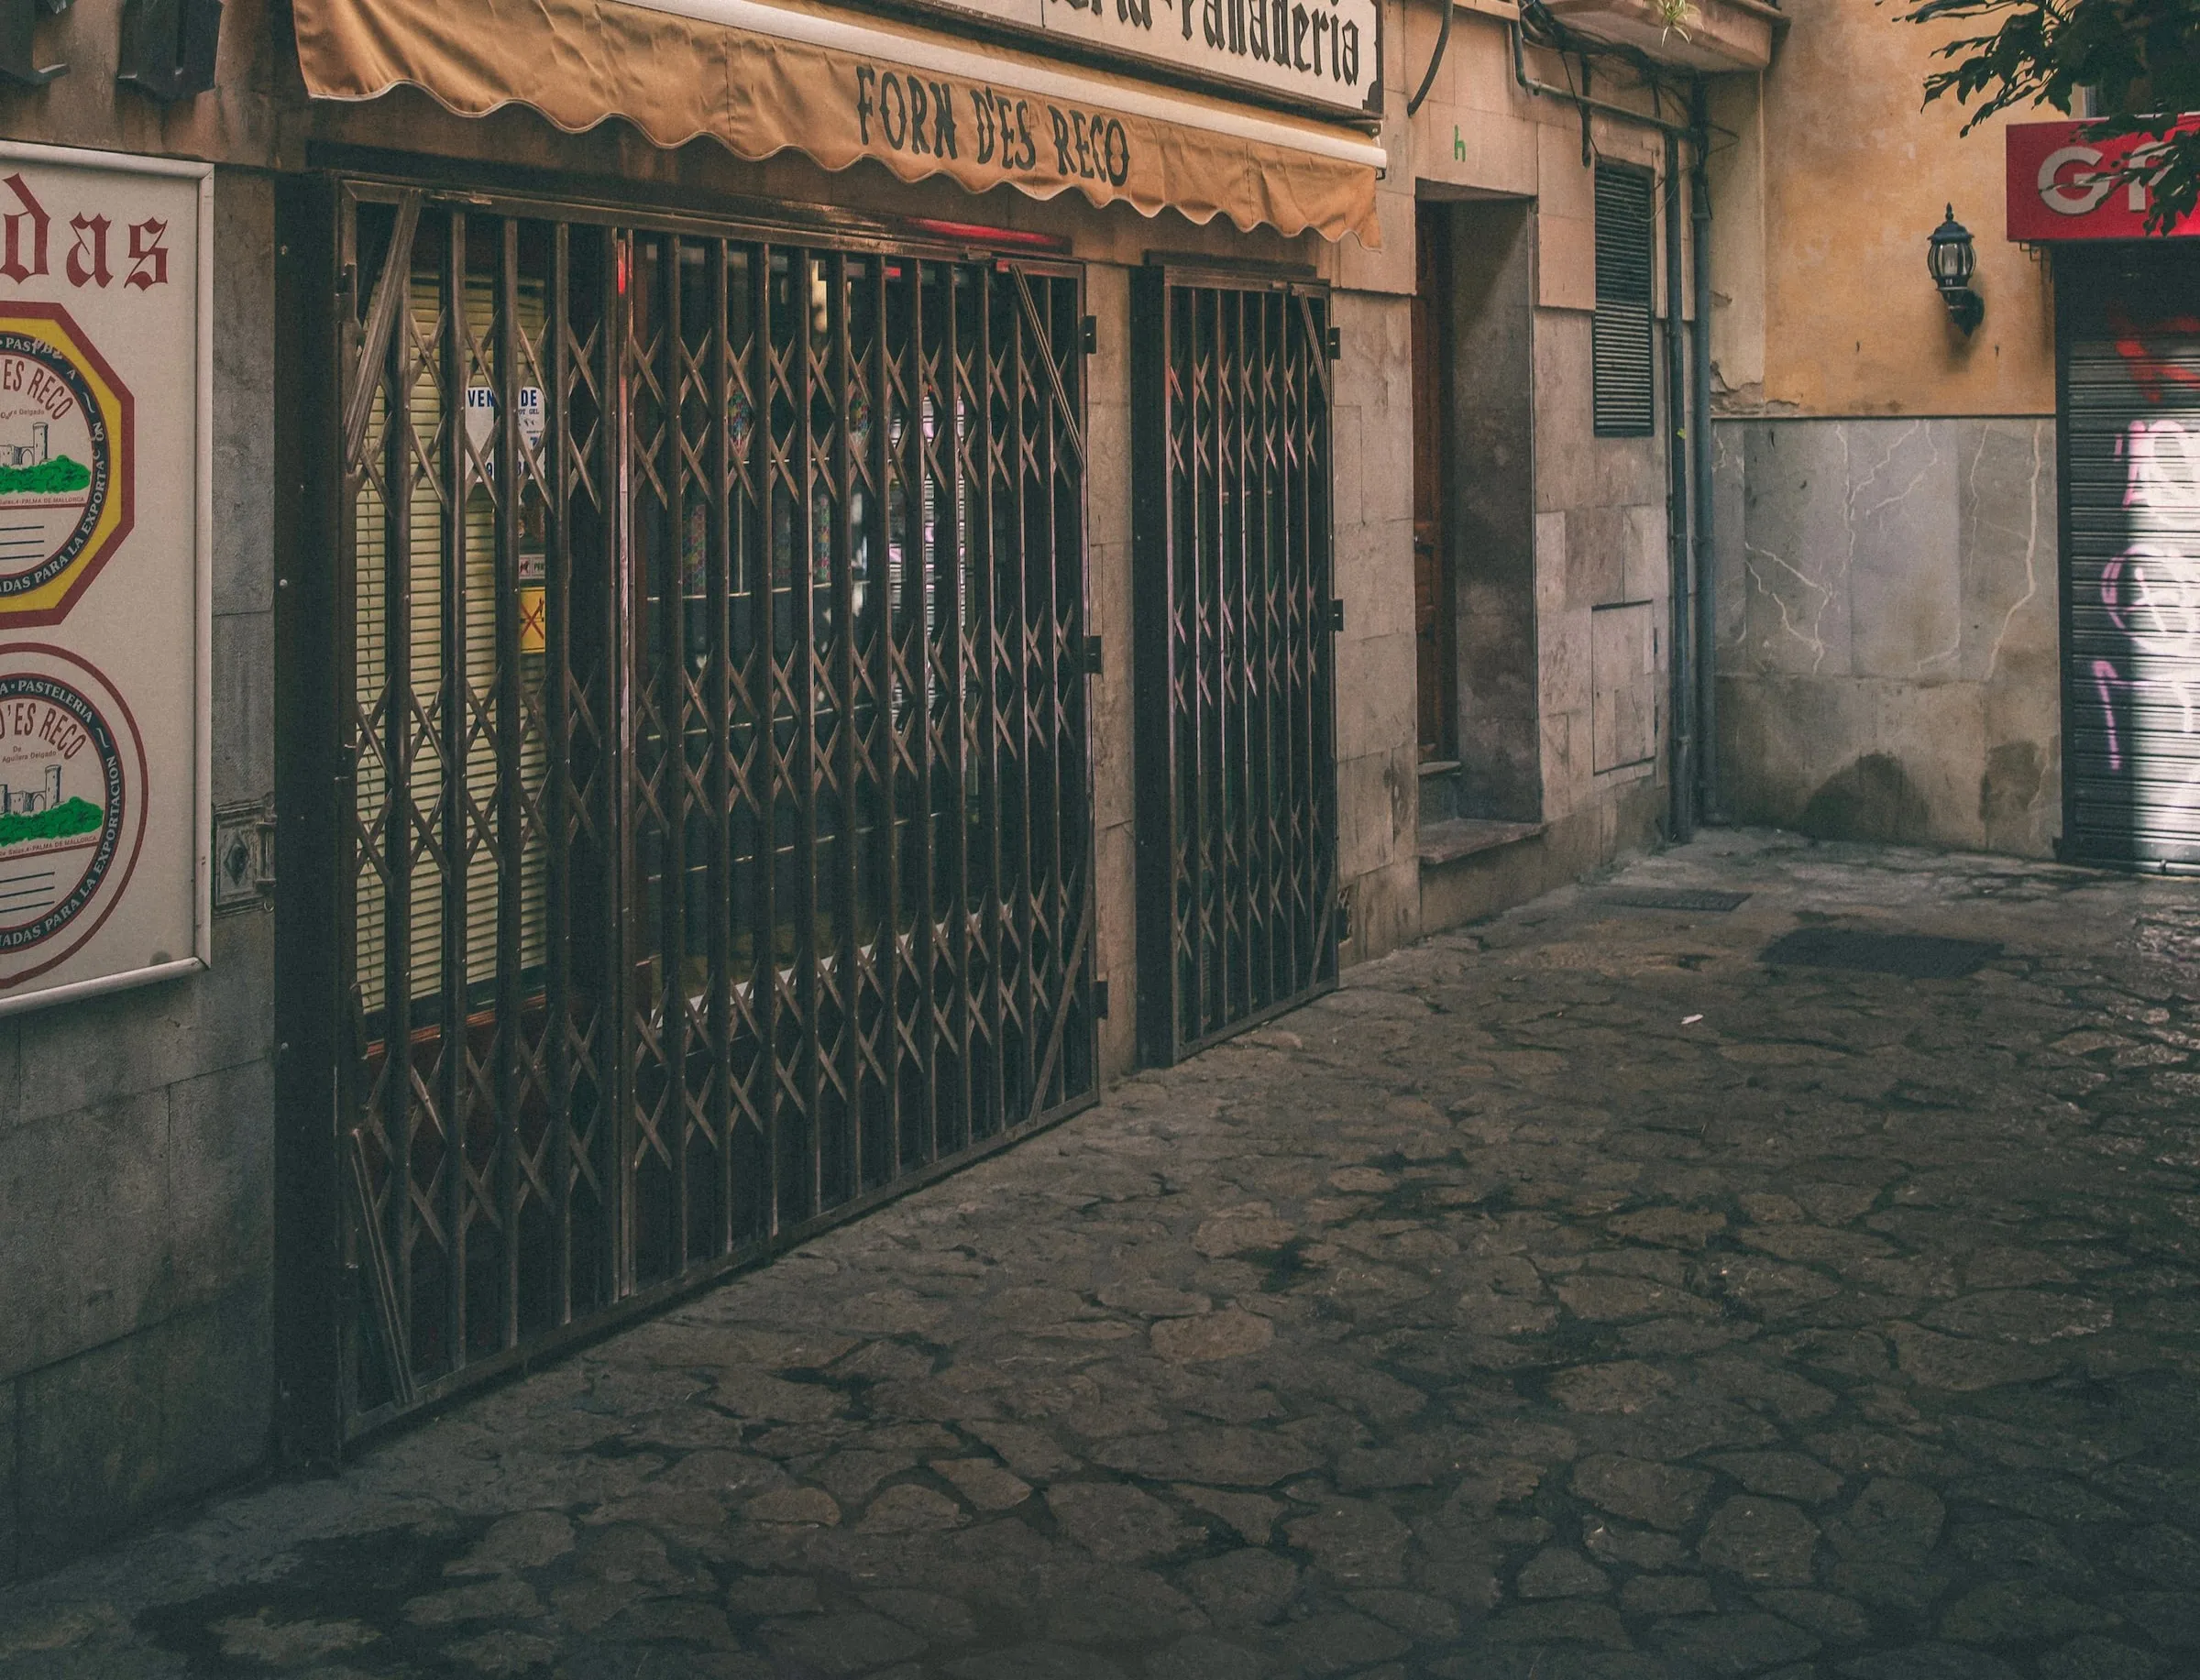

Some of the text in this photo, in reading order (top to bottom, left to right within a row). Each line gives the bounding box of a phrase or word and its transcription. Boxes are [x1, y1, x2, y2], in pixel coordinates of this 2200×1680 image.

[856, 65, 1130, 188] FORN D'ES RECO
[0, 172, 169, 291] das
[27, 368, 73, 420] RECO
[0, 576, 30, 593] DAS
[34, 555, 69, 584] PARA
[67, 536, 84, 555] LA
[18, 679, 93, 723] PASTELERIA
[38, 708, 86, 761] RECO
[0, 757, 122, 947] ADAS PARA LA EXPORTACION
